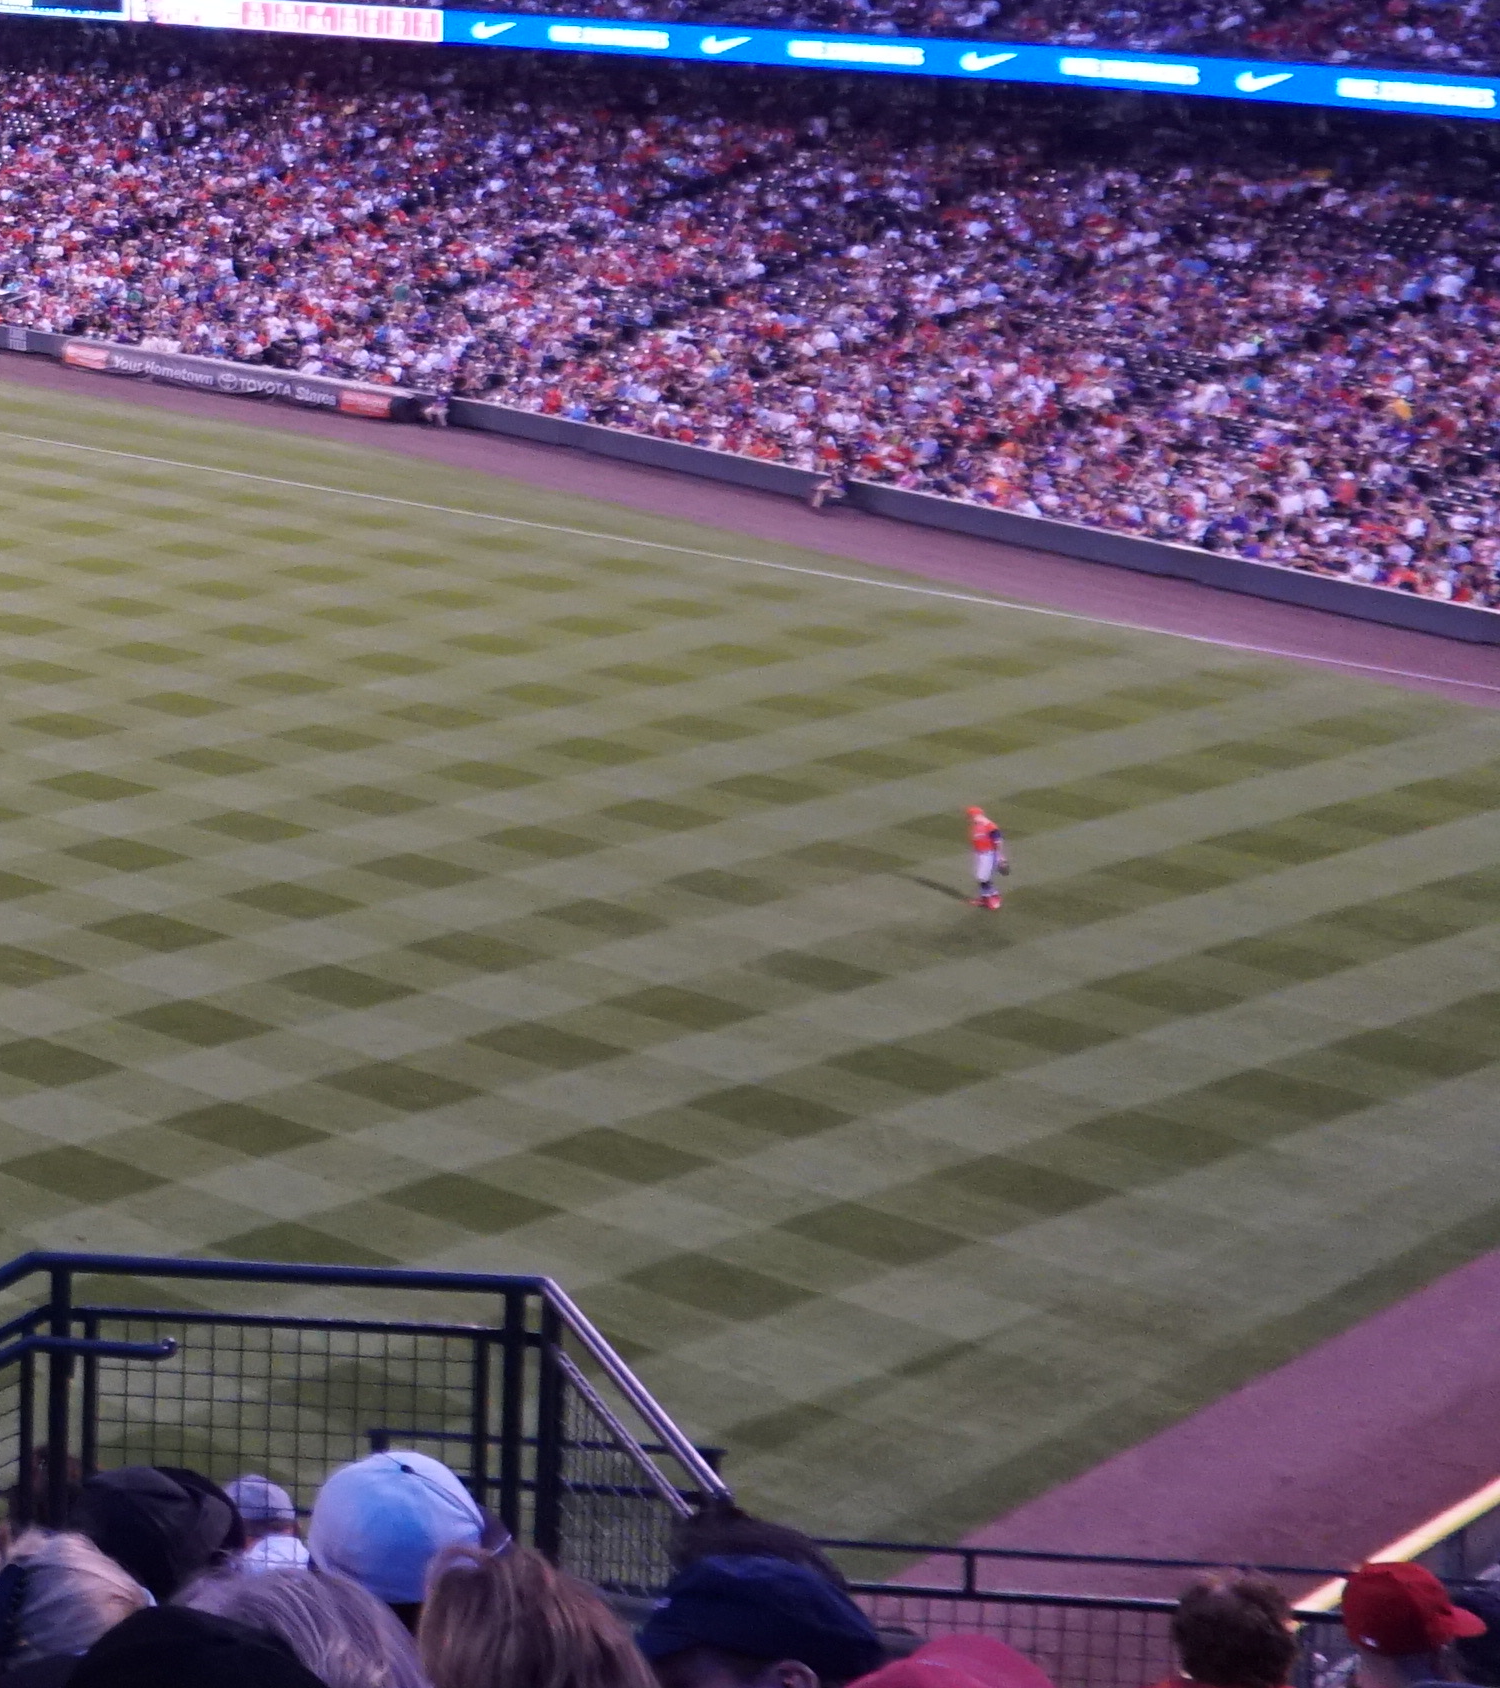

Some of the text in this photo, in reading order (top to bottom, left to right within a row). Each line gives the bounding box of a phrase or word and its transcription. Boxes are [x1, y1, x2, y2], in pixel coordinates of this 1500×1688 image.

[113, 355, 143, 375] Your
[144, 359, 214, 387] Hometown
[239, 377, 292, 397] TOYOTA
[295, 386, 337, 407] Stores
